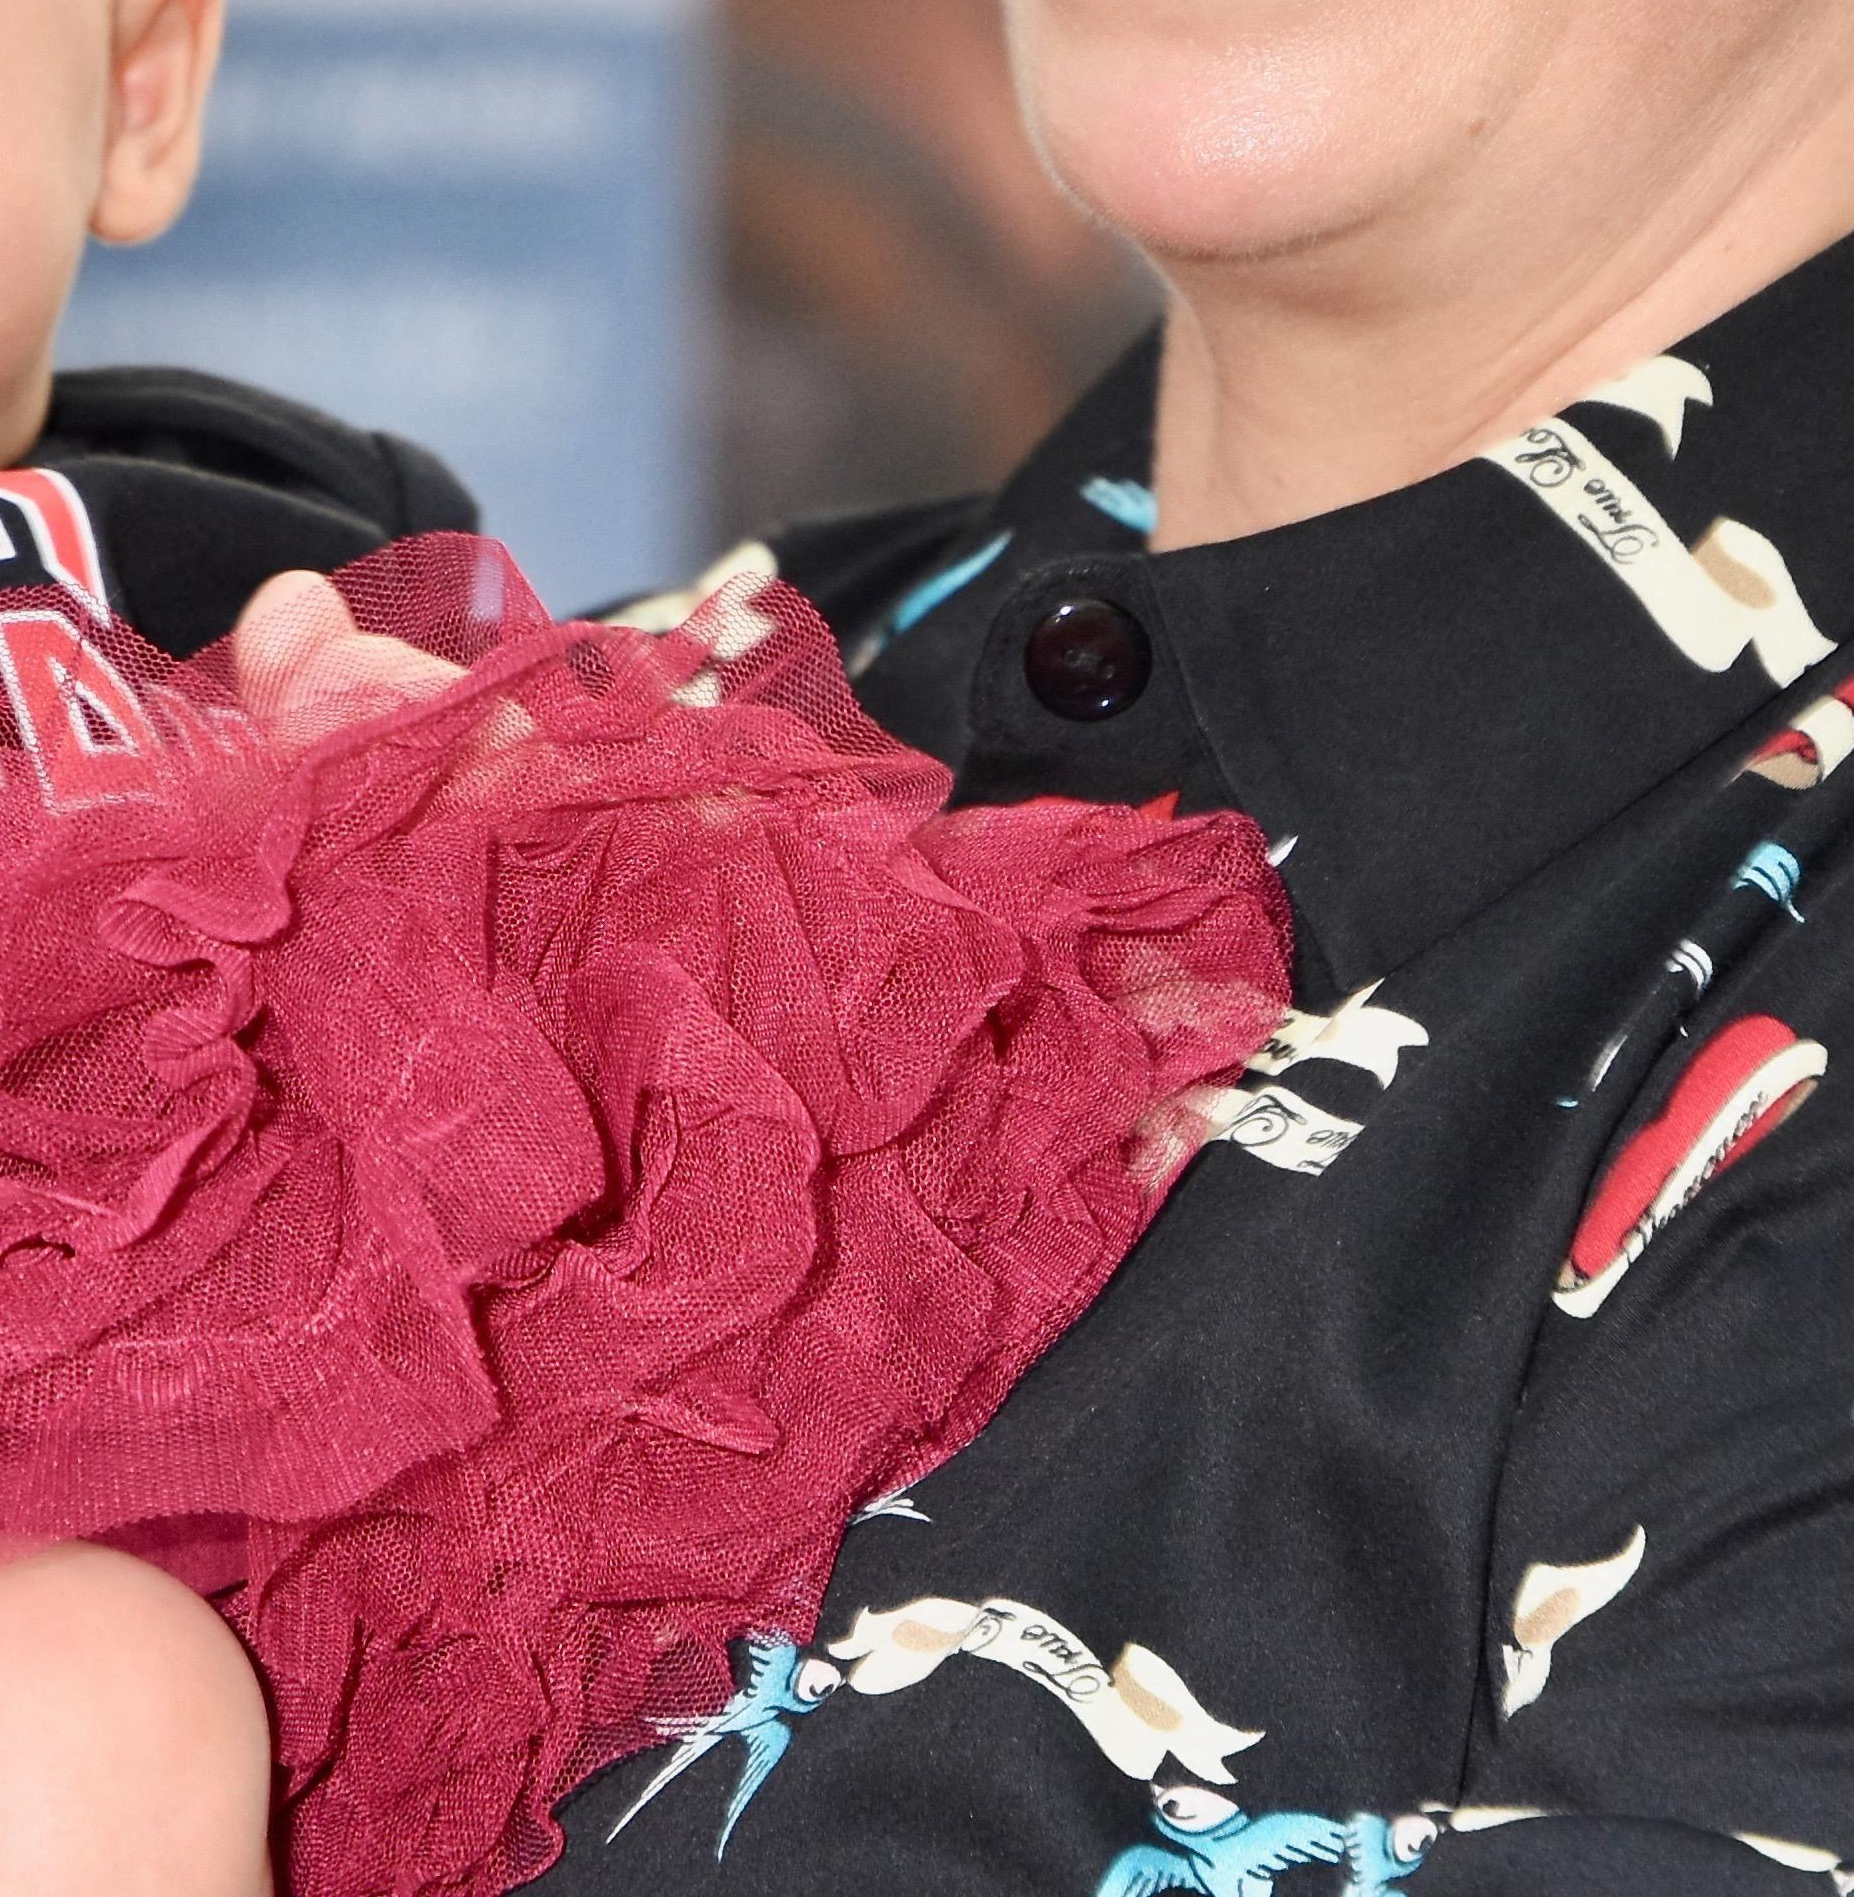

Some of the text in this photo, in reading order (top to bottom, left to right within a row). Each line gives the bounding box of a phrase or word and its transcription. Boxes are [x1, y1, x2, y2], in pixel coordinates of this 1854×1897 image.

[1515, 425, 1659, 564] True Lo
[1022, 1625, 1114, 1702] True
